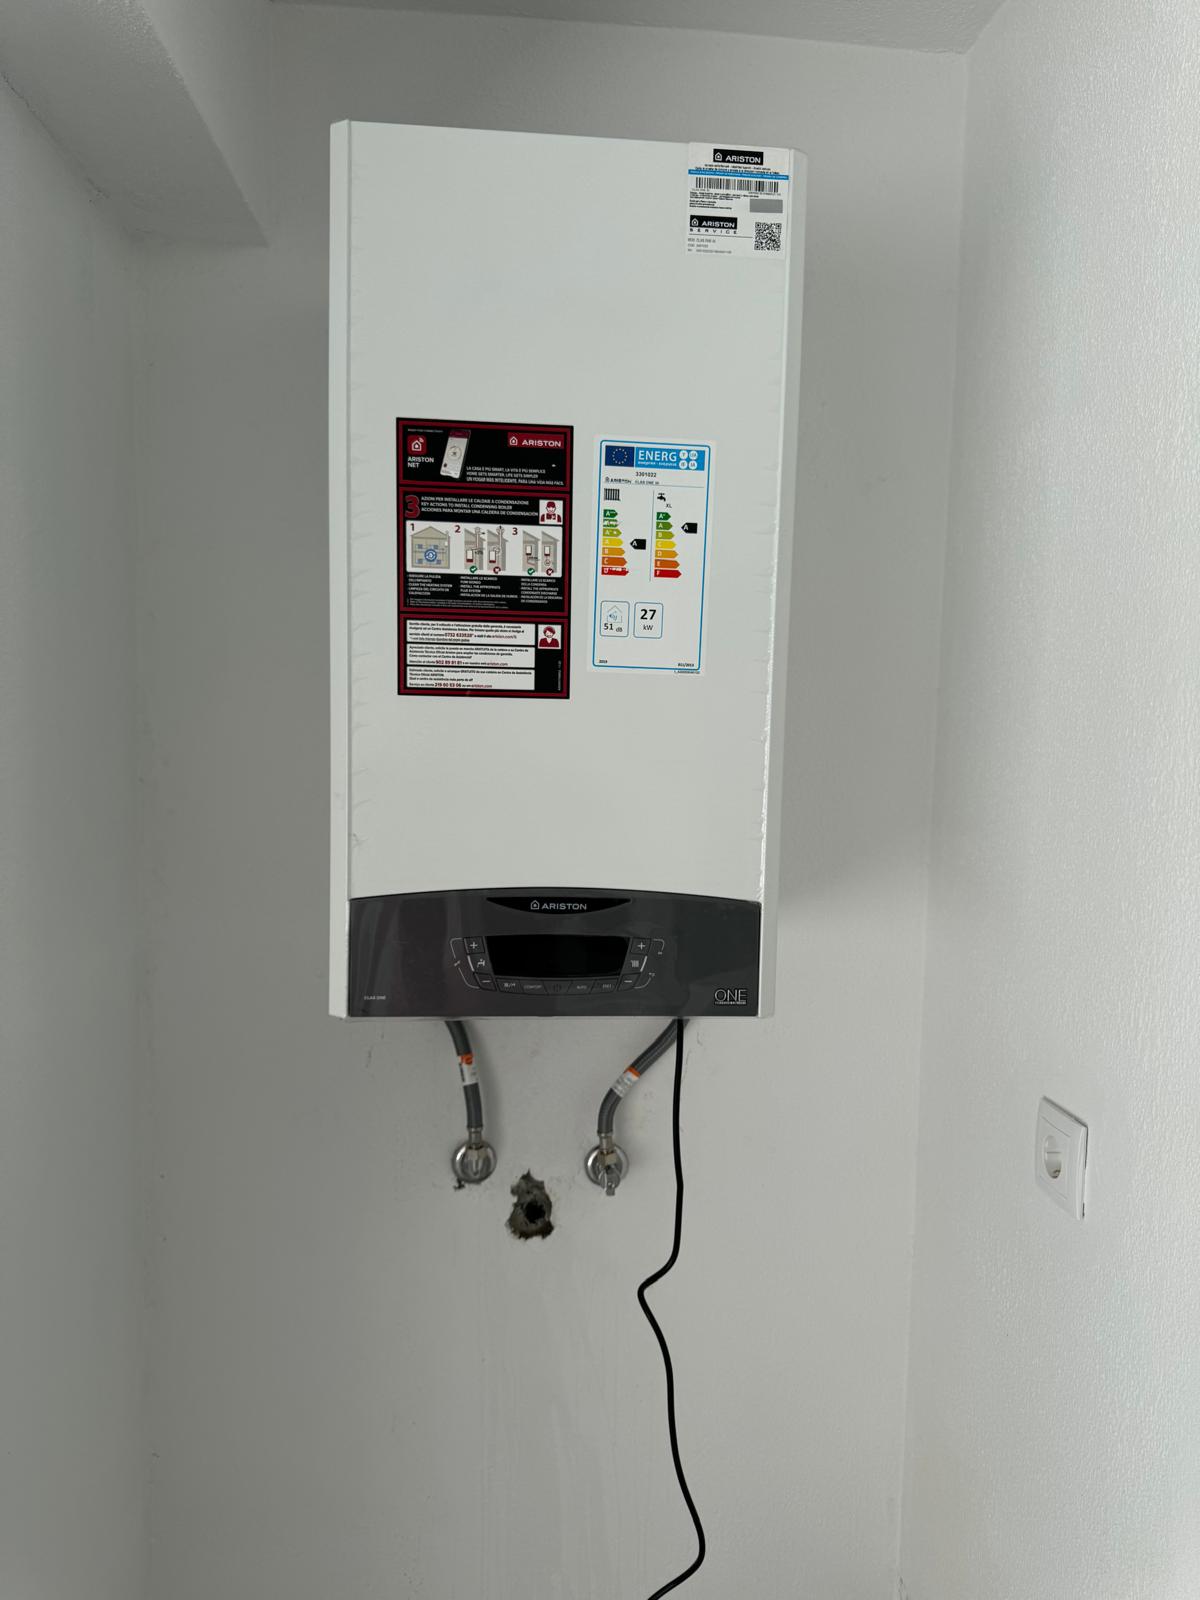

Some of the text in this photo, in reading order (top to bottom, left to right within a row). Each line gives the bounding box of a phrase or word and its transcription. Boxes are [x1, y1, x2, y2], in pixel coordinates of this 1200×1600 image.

[726, 155, 760, 163] ARISTON
[701, 220, 734, 228] ARISTON
[638, 450, 676, 461] ENERG
[405, 495, 419, 518] 3
[454, 525, 461, 533] 2
[512, 527, 518, 535] 3
[640, 609, 656, 620] 27
[715, 990, 746, 1001] ONE
